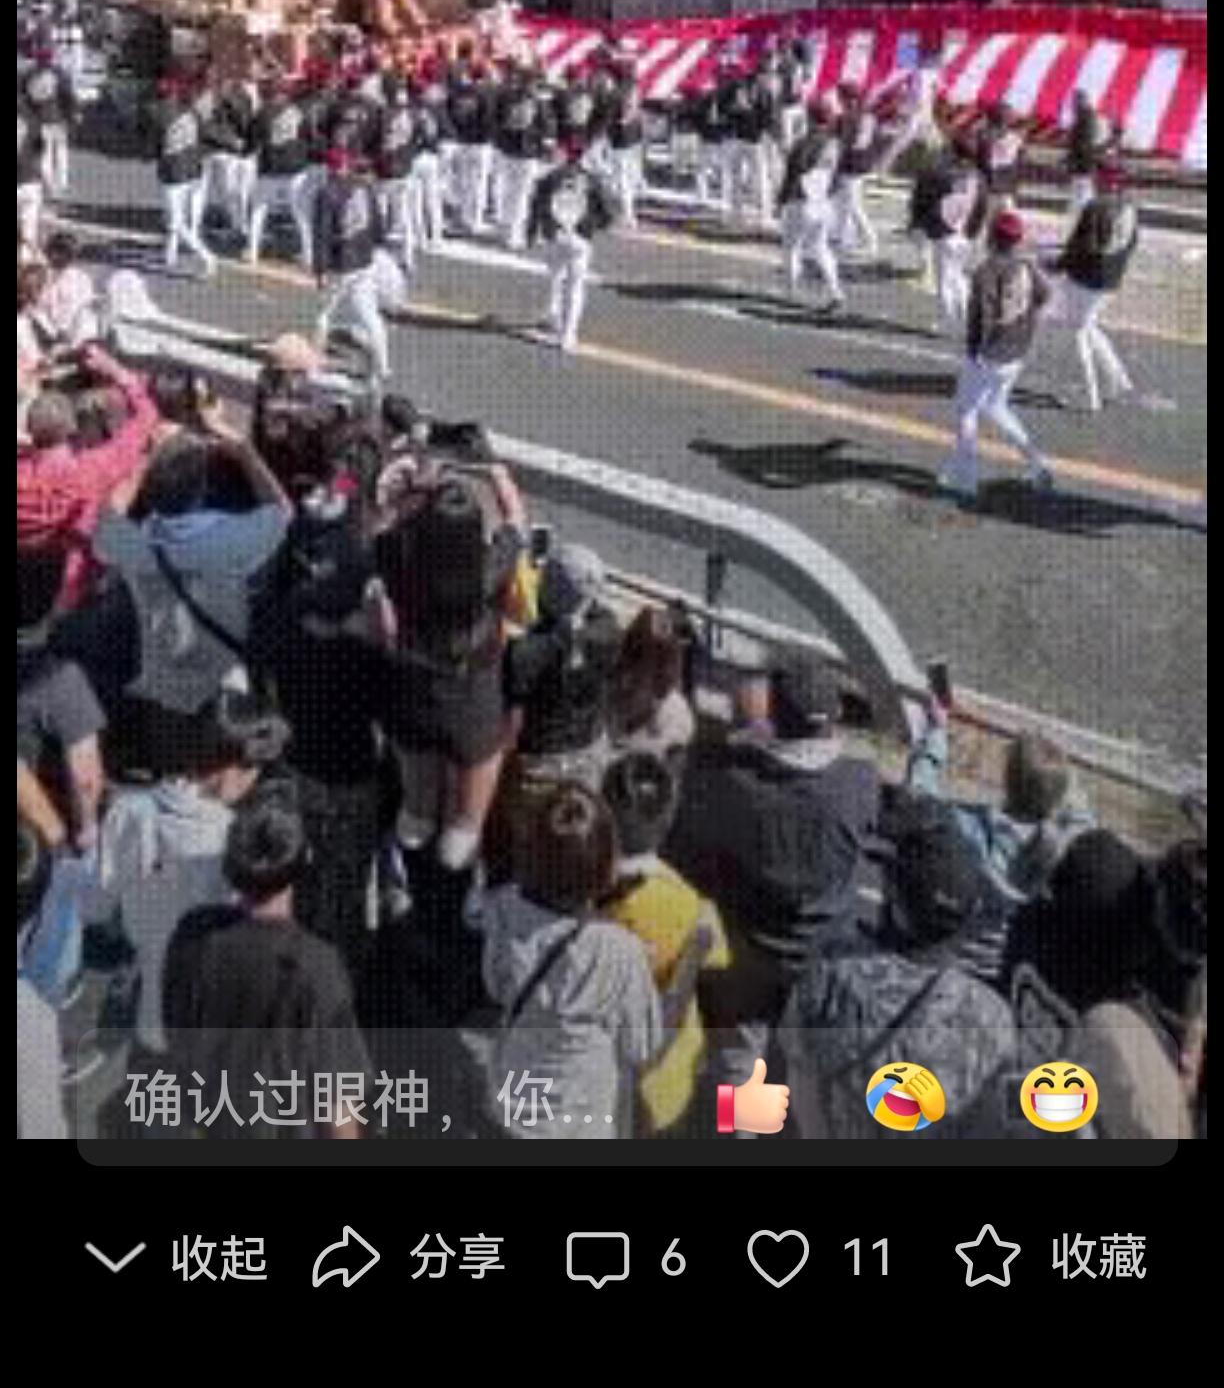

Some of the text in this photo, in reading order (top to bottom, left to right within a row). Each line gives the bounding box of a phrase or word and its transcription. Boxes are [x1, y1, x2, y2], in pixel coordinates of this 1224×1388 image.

[172, 1234, 267, 1281] 收起
[410, 1233, 505, 1279] 分享
[662, 1238, 686, 1276] 6
[845, 1238, 890, 1276] 11
[1052, 1233, 1146, 1279] 收藏
